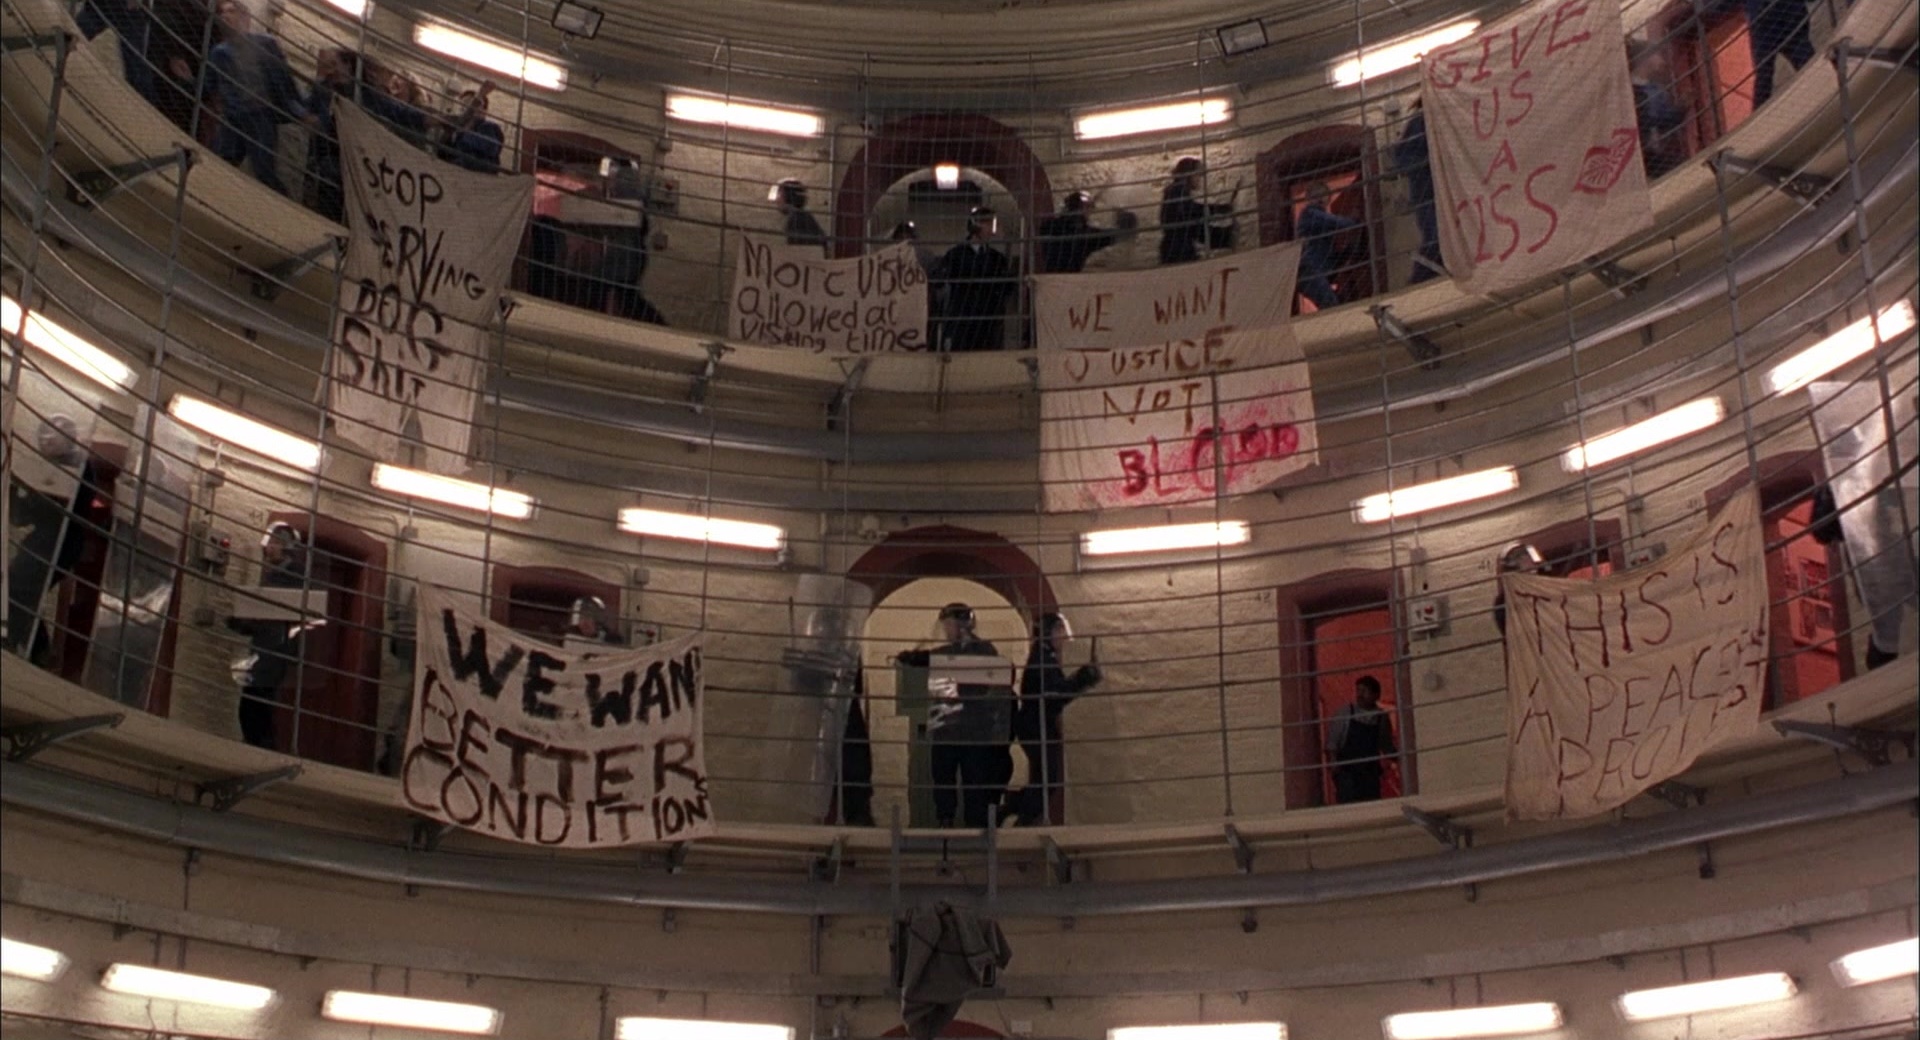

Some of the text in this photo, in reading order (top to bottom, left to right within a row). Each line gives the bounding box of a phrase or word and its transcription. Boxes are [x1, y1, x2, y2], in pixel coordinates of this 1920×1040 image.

[1429, 0, 1591, 89] GIVE
[1473, 70, 1533, 140] US
[1483, 139, 1517, 185] A
[354, 277, 450, 372] DOG
[1068, 267, 1240, 332] WE WANT
[847, 326, 928, 353] time
[1063, 325, 1234, 382] JUSTICE
[1102, 382, 1201, 433] NOT
[1116, 422, 1300, 497] BLOOD
[1514, 521, 1739, 672] THIS IS
[443, 608, 567, 720] WE
[421, 663, 703, 807] BETTER
[1515, 677, 1555, 745] A
